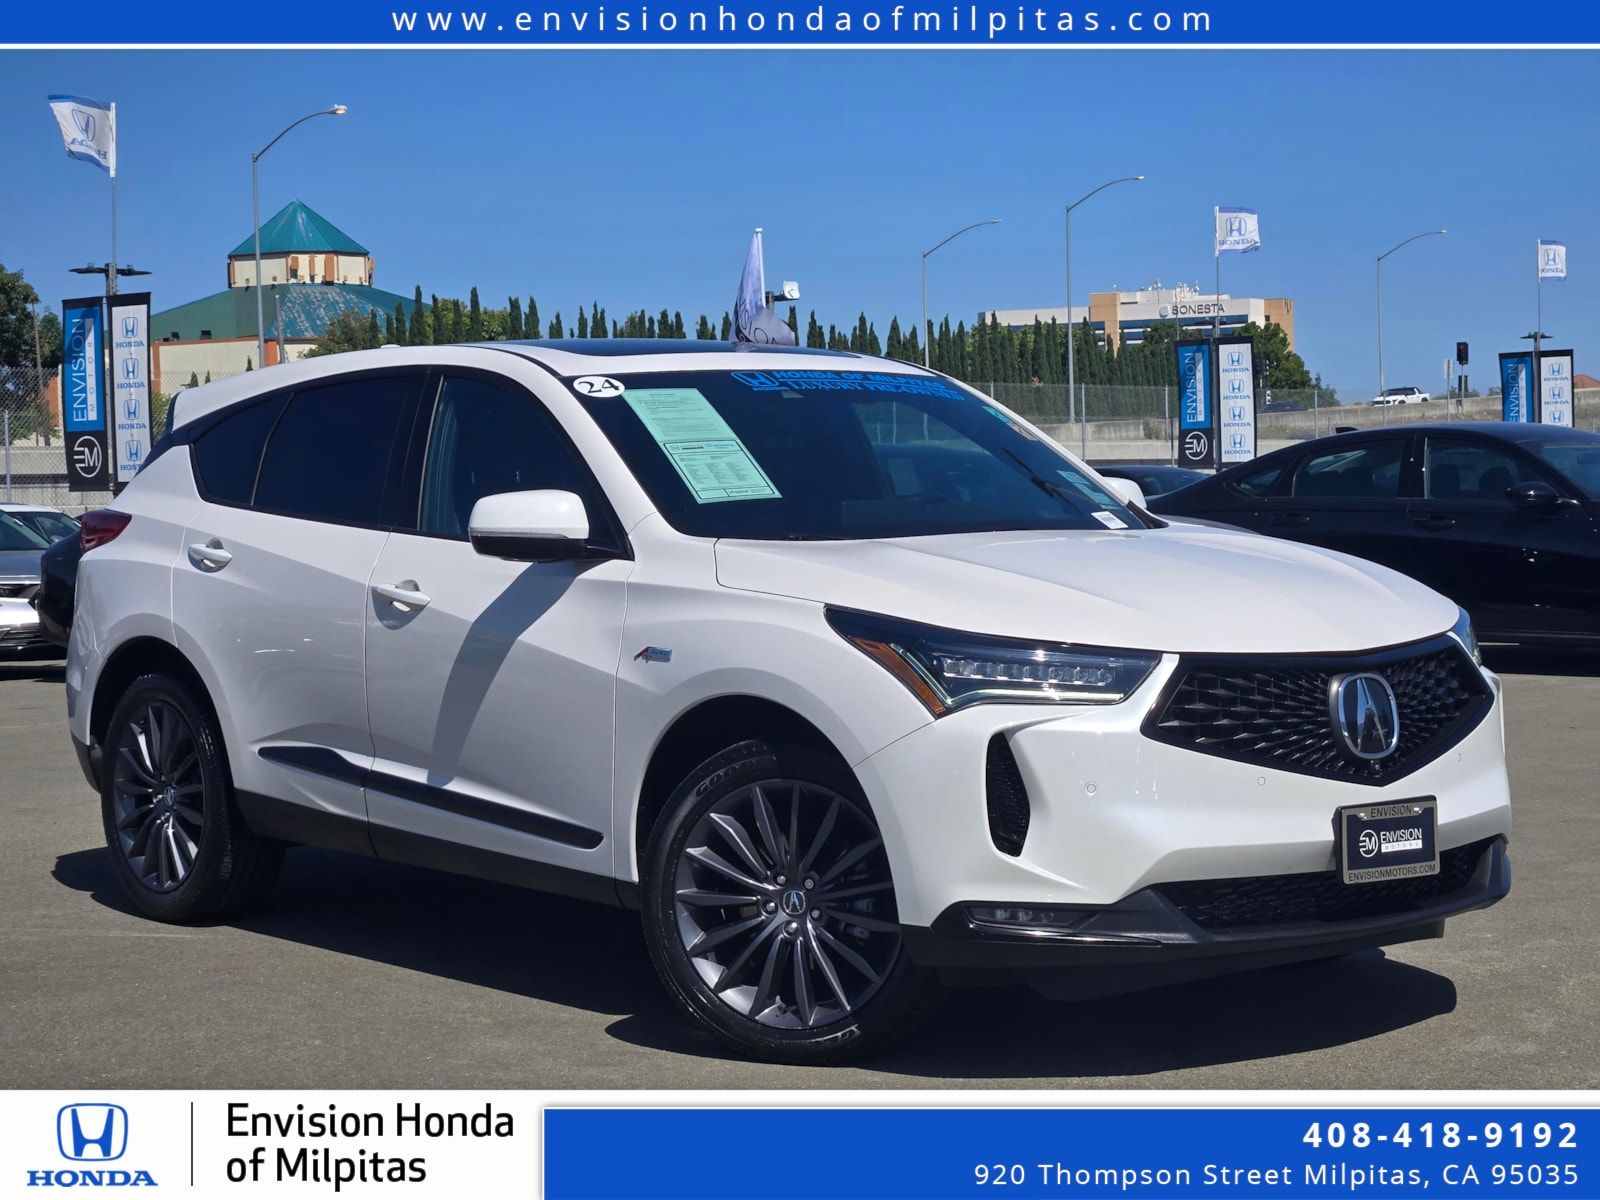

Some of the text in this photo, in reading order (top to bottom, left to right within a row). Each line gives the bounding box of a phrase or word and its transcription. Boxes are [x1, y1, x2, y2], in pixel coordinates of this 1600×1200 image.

[1172, 303, 1226, 316] SONESTA
[115, 340, 145, 349] HONDA
[71, 318, 88, 422] ENVISION
[116, 381, 146, 390] HONDA
[577, 378, 621, 394] 24
[1184, 352, 1198, 423] ENVISION
[118, 422, 147, 430] HONDA
[1370, 804, 1412, 818] ENVISION
[1379, 827, 1423, 844] ENVISION
[1348, 863, 1436, 882] ENVISIONMOTORS.COM
